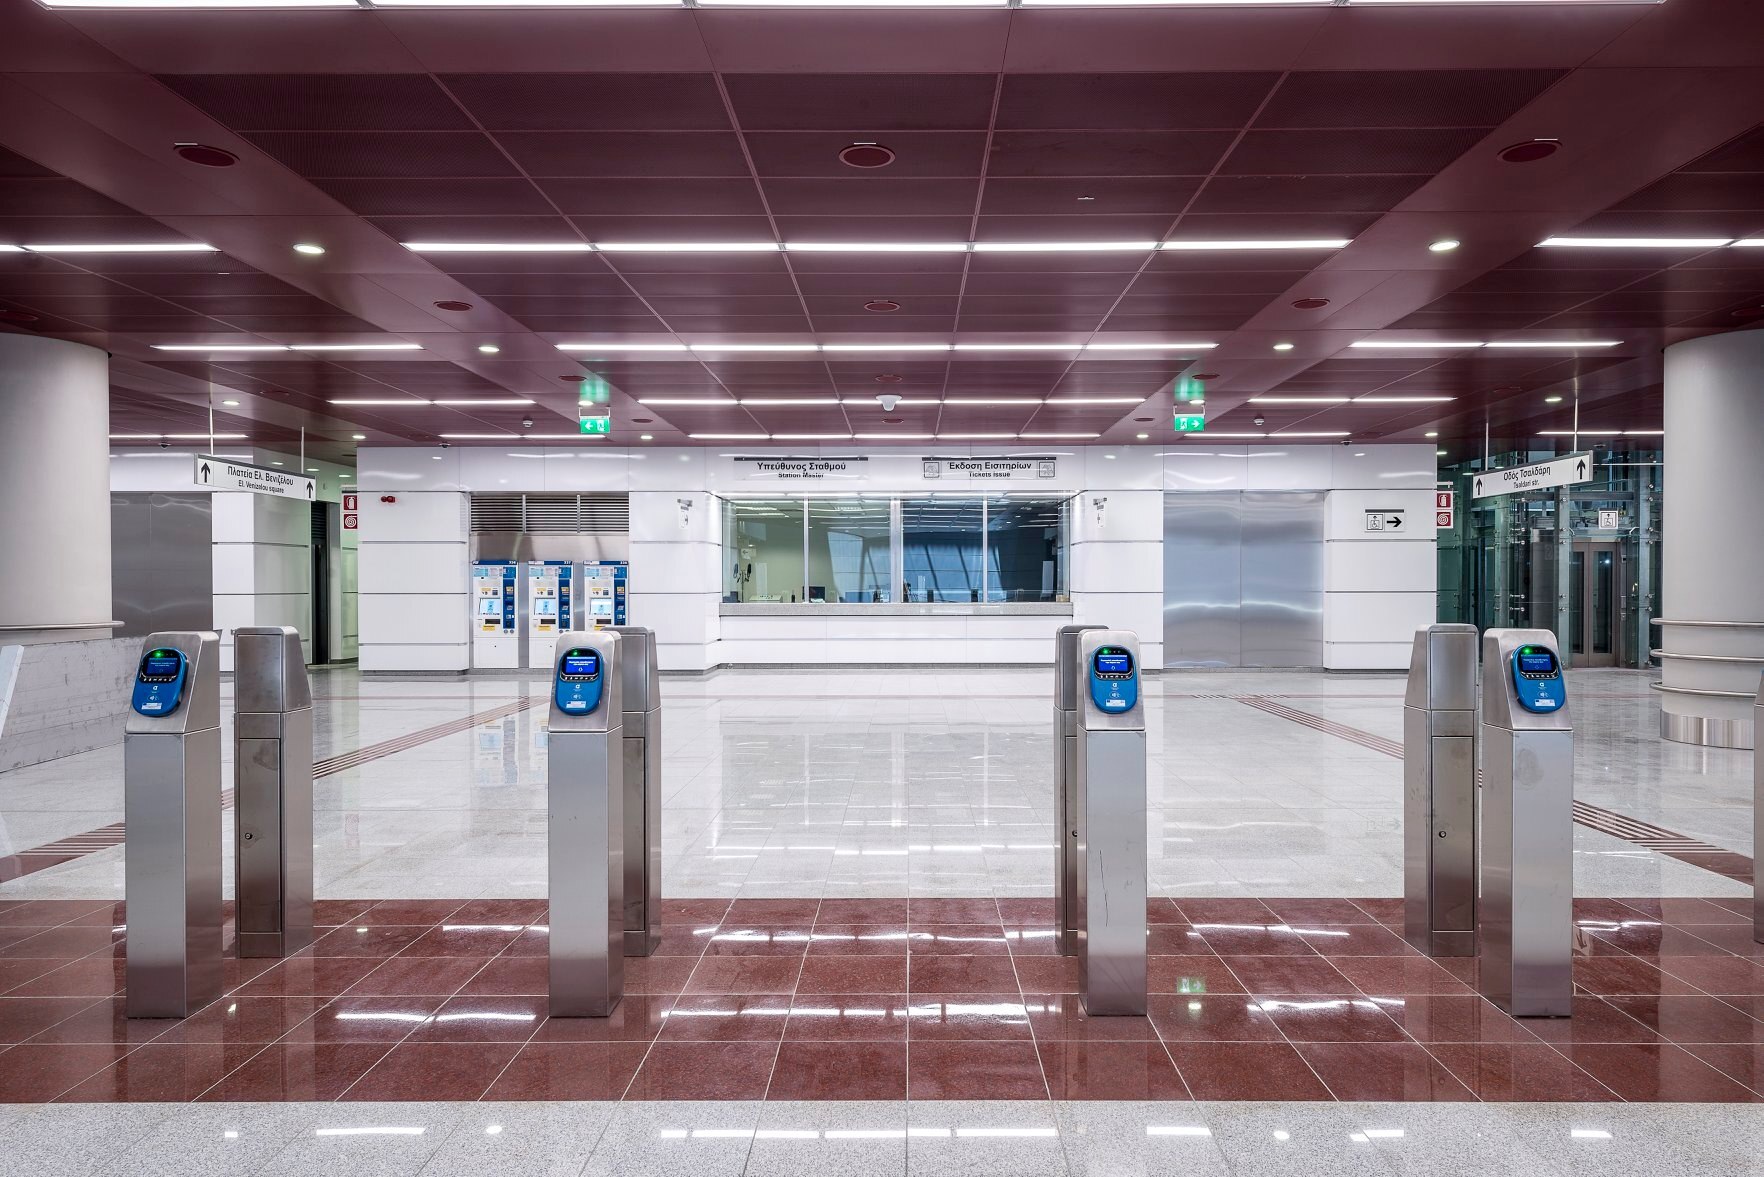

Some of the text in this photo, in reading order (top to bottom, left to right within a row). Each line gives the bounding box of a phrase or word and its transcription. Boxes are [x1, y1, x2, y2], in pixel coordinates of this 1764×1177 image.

[757, 462, 846, 471] Υπεύθυνος Σταθμού
[947, 461, 1031, 471] Έκδοση Εισιτηρίων
[227, 466, 294, 486] Πλατεία Ελ. Βενιζέλου
[1504, 466, 1551, 481] Οδός Τσαλδάρη
[1513, 480, 1531, 489] Tsaldari
